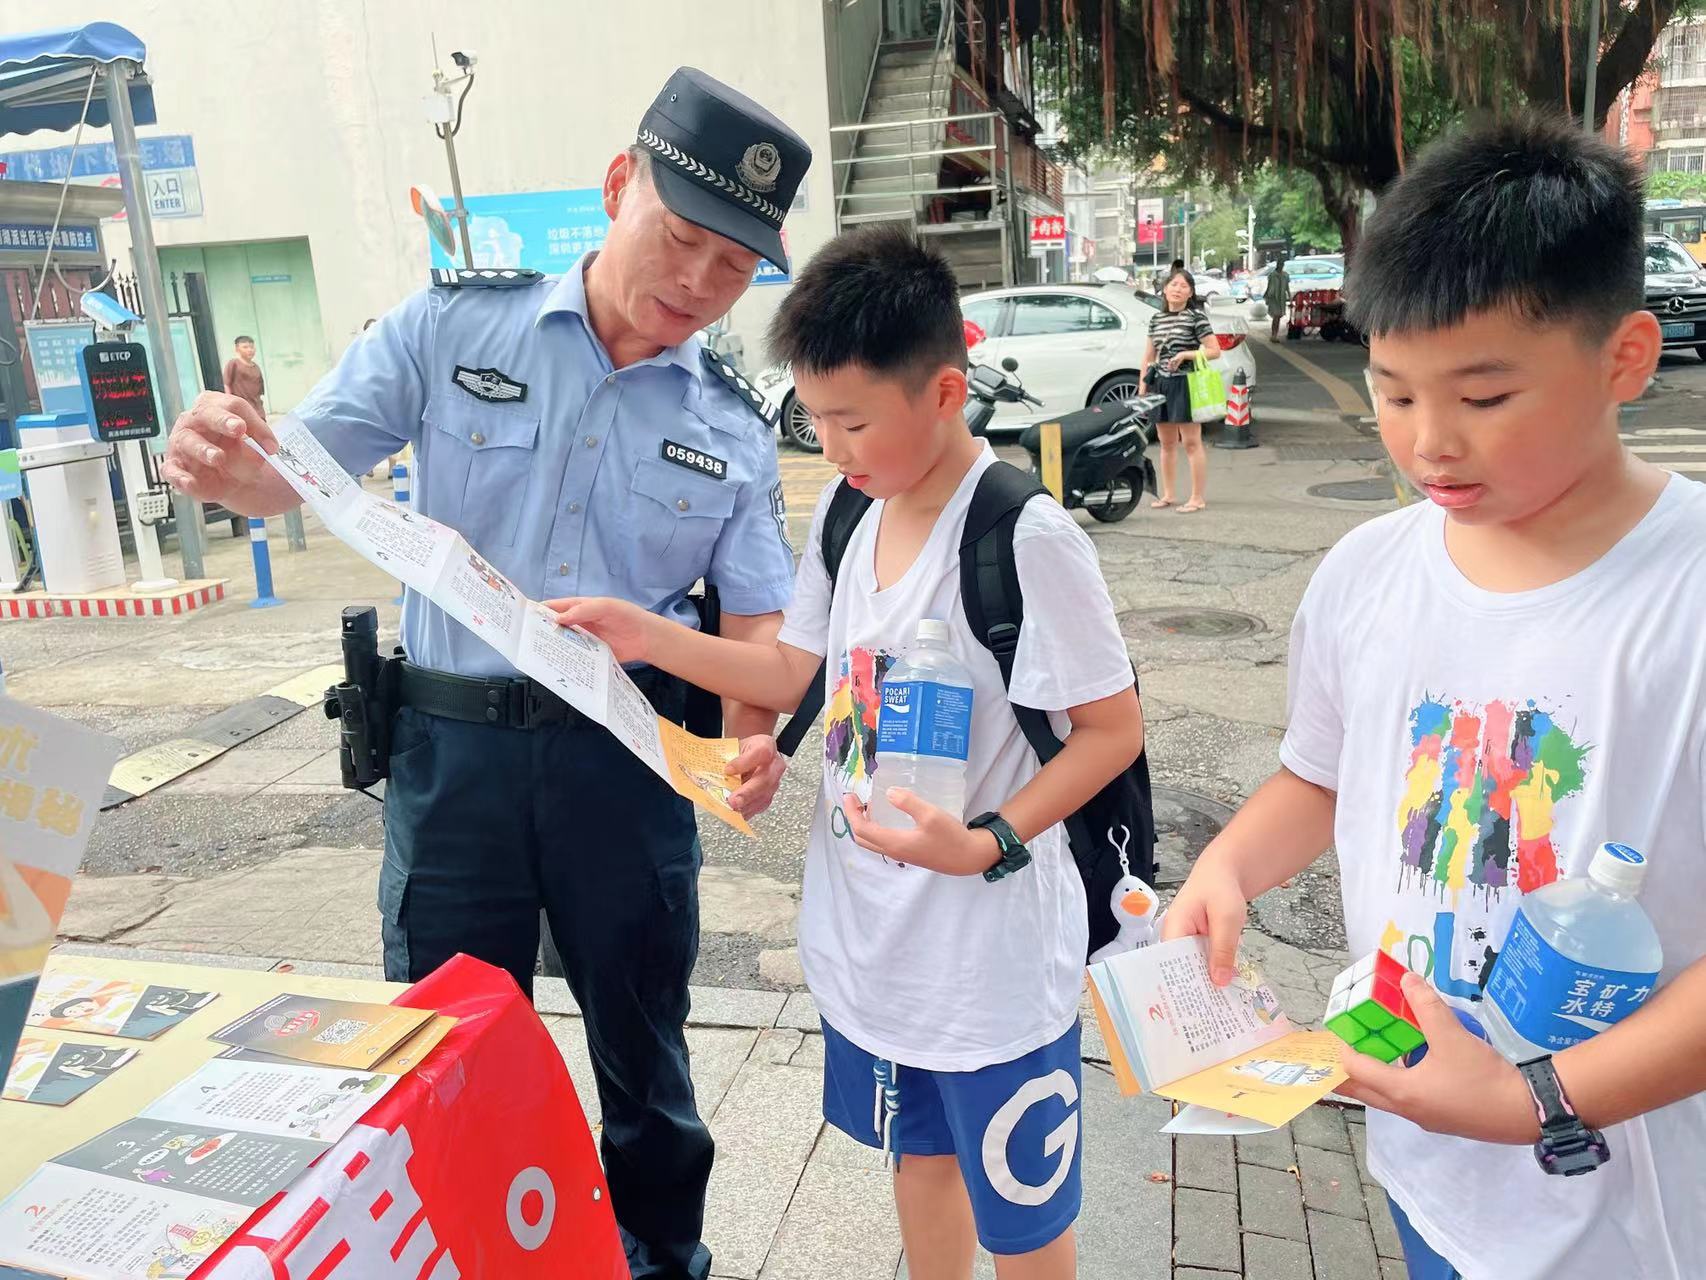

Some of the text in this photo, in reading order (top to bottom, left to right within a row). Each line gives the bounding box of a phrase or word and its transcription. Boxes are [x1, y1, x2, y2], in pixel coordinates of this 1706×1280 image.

[152, 177, 180, 196] 入口
[154, 197, 182, 210] ENTER
[666, 445, 723, 475] 059438
[884, 695, 907, 704] SWEAT
[885, 687, 910, 696] POCARI
[1567, 979, 1651, 1003] 宝矿力
[1560, 997, 1616, 1018] 水特
[982, 1068, 1079, 1207] G
